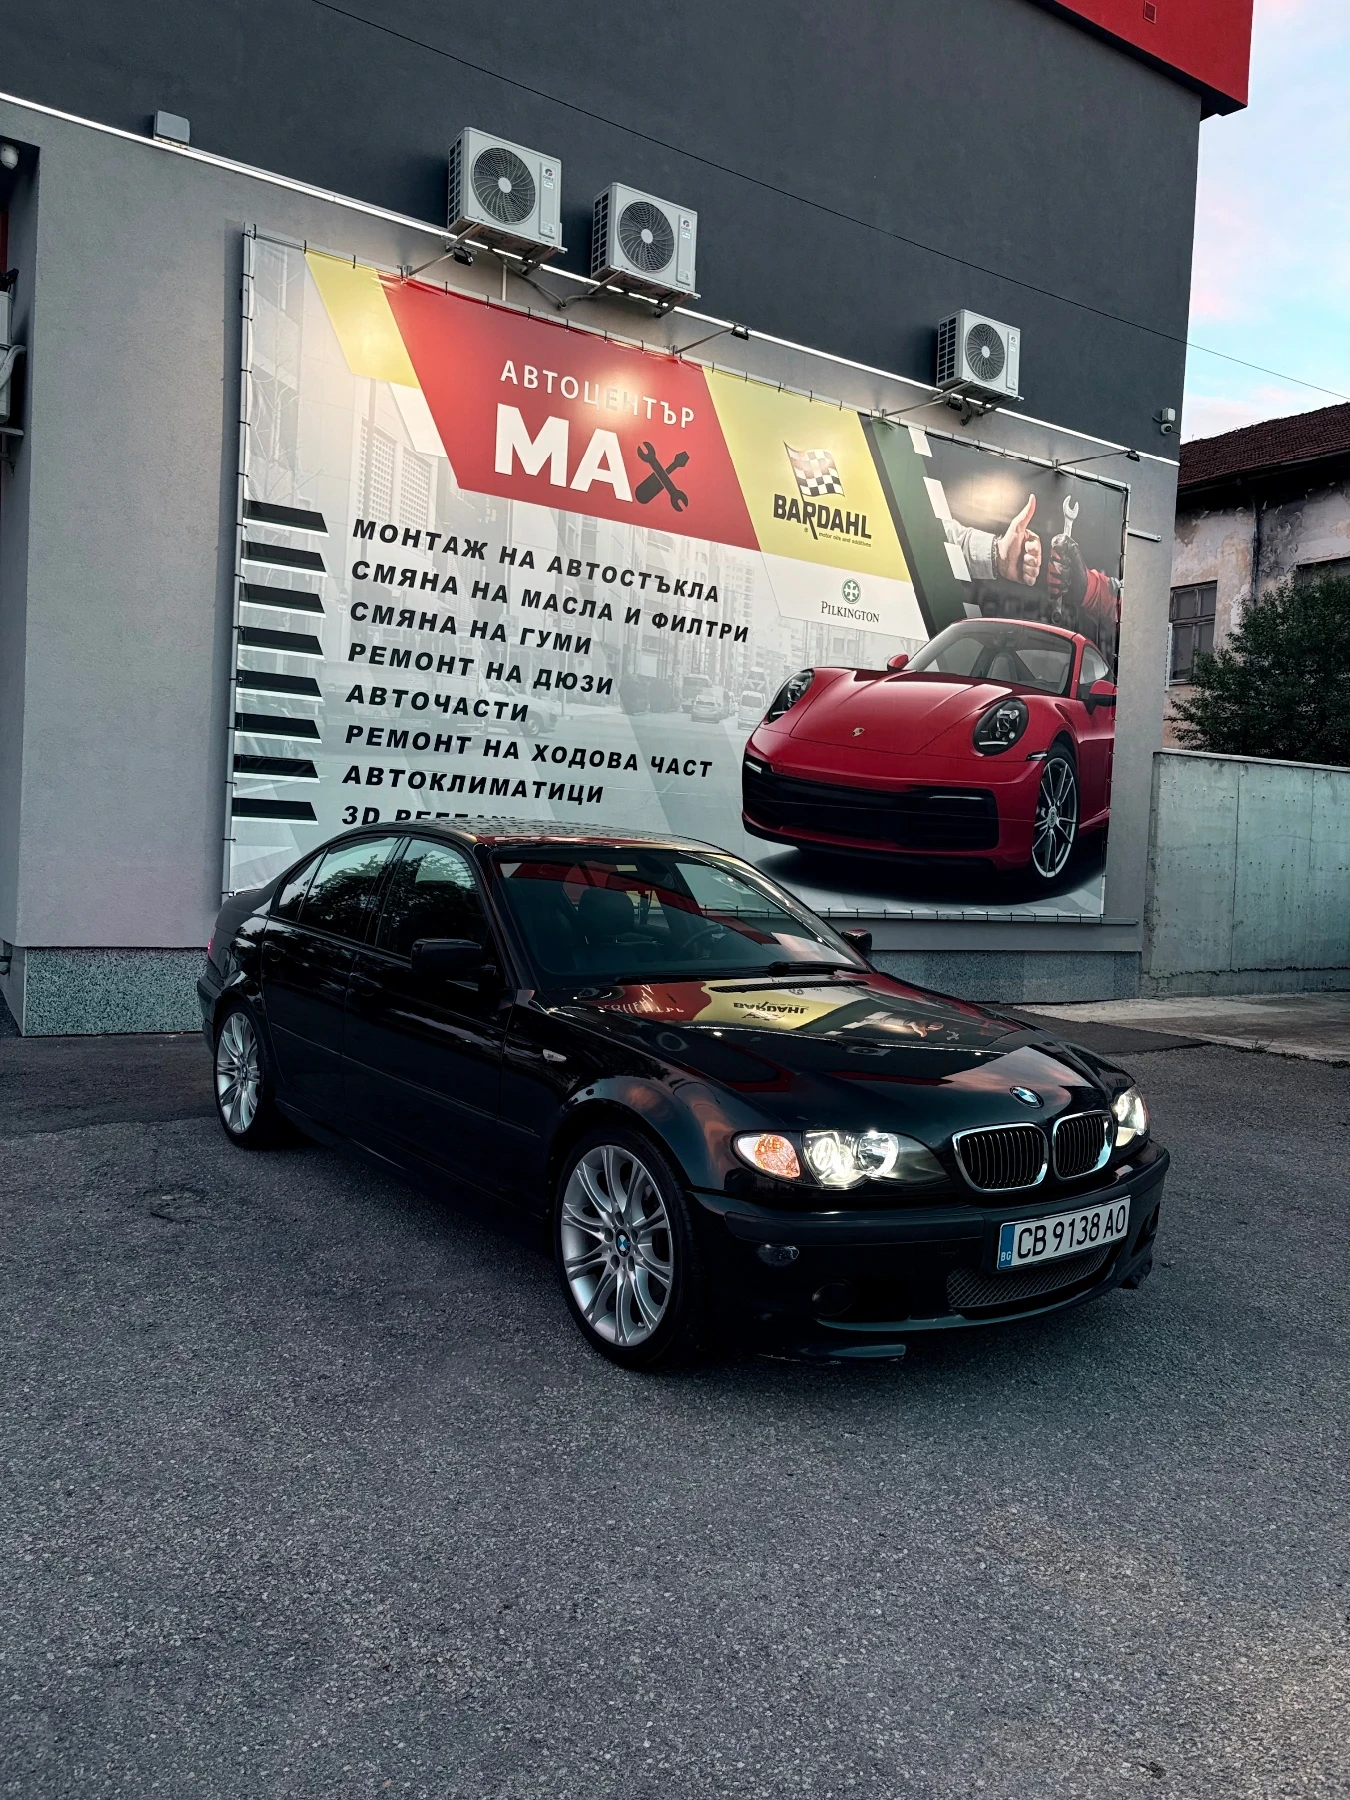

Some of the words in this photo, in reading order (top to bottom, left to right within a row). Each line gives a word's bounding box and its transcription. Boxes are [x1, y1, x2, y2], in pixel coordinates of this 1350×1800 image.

[500, 360, 695, 428] АВТОЦЕНТЪР
[773, 493, 872, 540] BARDAHL
[352, 518, 488, 561] МОНТАЖ
[499, 545, 535, 570] НА
[546, 555, 719, 603] АВТОСТЪКЛА
[351, 560, 458, 596] СМЯНА
[471, 580, 508, 604] НА
[521, 588, 613, 622] МАСЛА
[624, 606, 641, 626] И
[651, 612, 749, 643] ФИЛТРИ
[820, 600, 880, 623] PILKINGTON
[350, 601, 457, 635] СМЯНА
[469, 619, 507, 643] НА
[519, 627, 593, 655] ГУМИ
[347, 642, 475, 676] РЕМОНТ
[485, 661, 522, 684] НА
[532, 668, 614, 696] ДЮЗИ
[344, 684, 529, 723] АВТОЧАСТИ
[344, 724, 472, 755] РЕМОНТ
[482, 738, 519, 760] НА
[531, 743, 638, 771] ХОДОВА
[650, 755, 713, 778] ЧАСТ
[341, 765, 604, 806] АВТОКЛИМАТИЦИ
[341, 805, 381, 826] 3D
[1000, 1250, 1012, 1262] BG
[1017, 1224, 1047, 1259] CB
[1052, 1212, 1101, 1253] 9138
